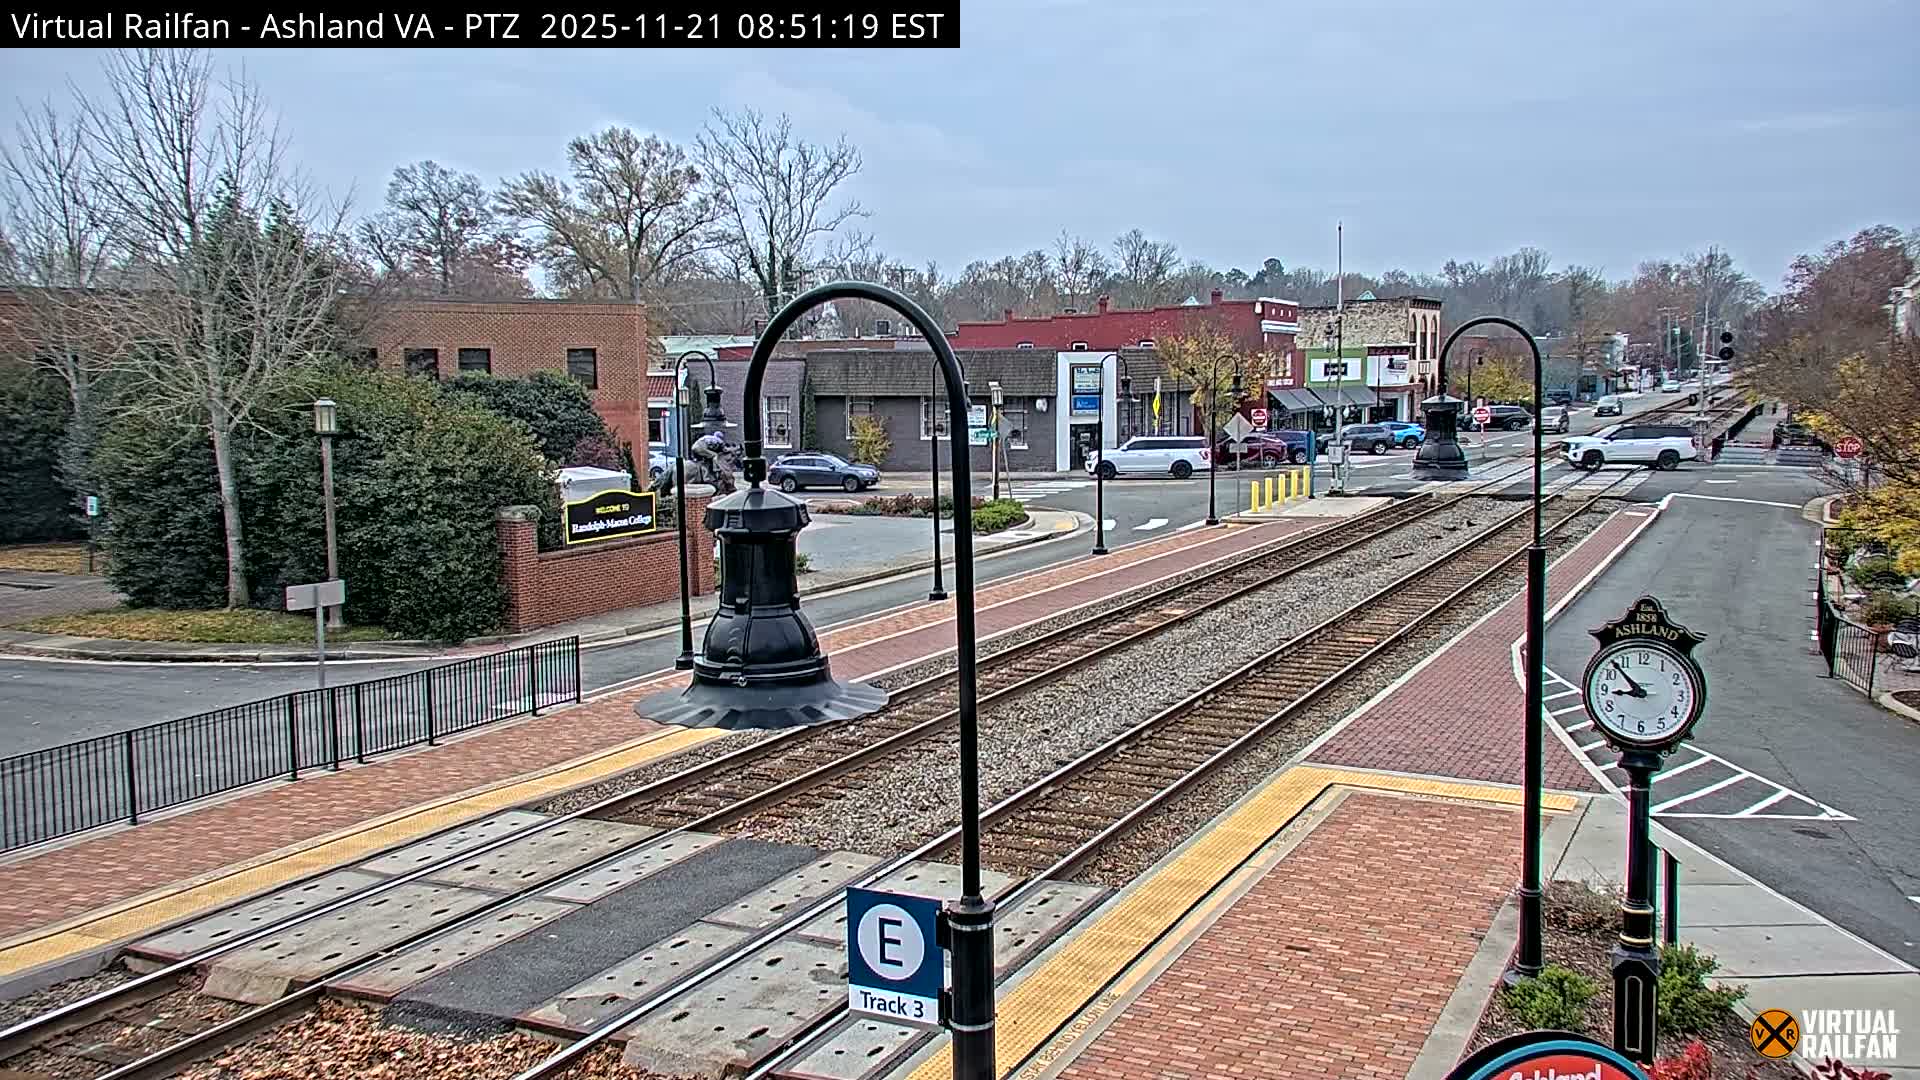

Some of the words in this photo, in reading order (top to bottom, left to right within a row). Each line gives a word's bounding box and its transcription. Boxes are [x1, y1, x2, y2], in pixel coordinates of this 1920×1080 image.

[1836, 443, 1860, 452] STOP
[595, 505, 621, 514] WELCOME
[622, 503, 630, 511] TO
[572, 519, 628, 533] Randolph-Macon
[629, 515, 652, 525] College
[1616, 624, 1678, 640] ASHLAND
[1621, 656, 1629, 668] 11
[1638, 653, 1649, 665] 12
[1660, 660, 1664, 672] 1
[1605, 669, 1616, 680] 10
[1673, 674, 1680, 685] 2
[1601, 684, 1608, 696] 9
[1678, 691, 1684, 702] 3
[1605, 700, 1614, 712] 8
[1671, 706, 1678, 718] 4
[1618, 715, 1625, 728] 7
[1638, 721, 1645, 732] 6
[1658, 718, 1665, 730] 5
[879, 917, 903, 967] E
[860, 991, 907, 1016] Track
[914, 1000, 924, 1018] 3
